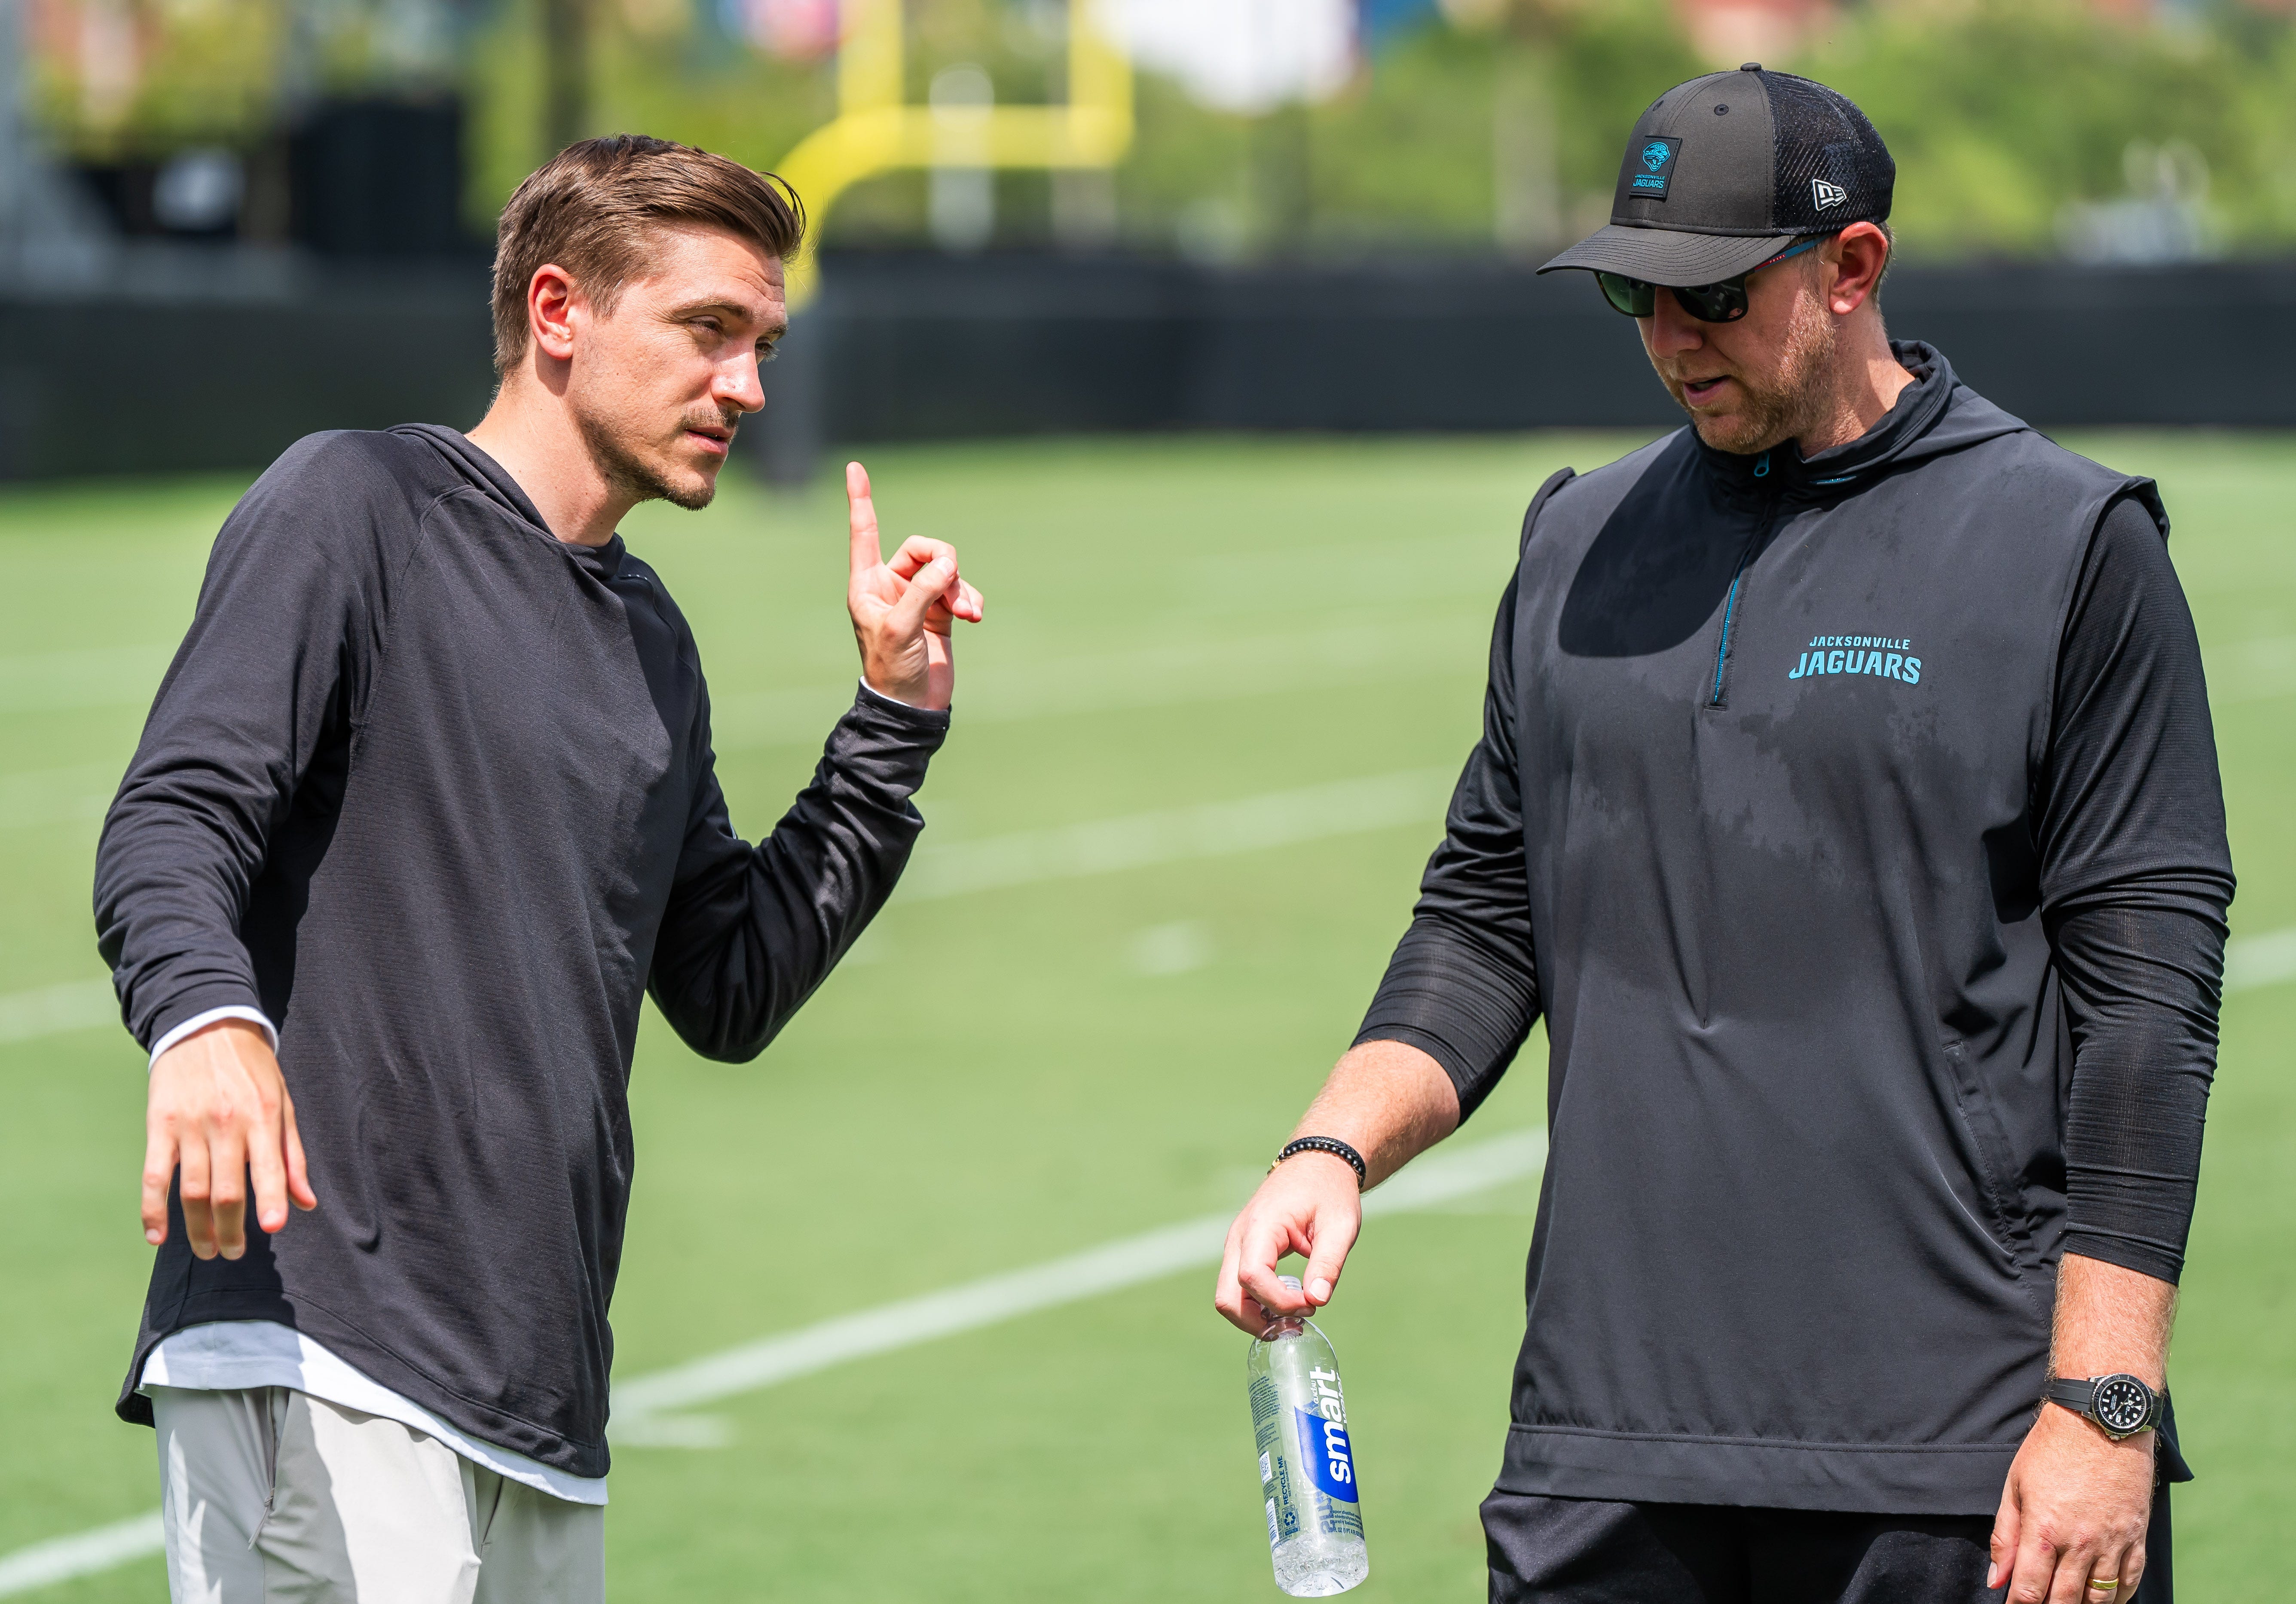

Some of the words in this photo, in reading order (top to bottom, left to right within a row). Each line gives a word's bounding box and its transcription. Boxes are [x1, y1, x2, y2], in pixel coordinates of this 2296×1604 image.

[1633, 179, 1664, 188] JAGUARS
[1809, 636, 1910, 650] JACKSONVILLE
[1788, 650, 1921, 684] JAGUARS
[1309, 1366, 1351, 1484] smart
[1278, 1455, 1284, 1469] ME
[1279, 1469, 1289, 1505] RECYCLE
